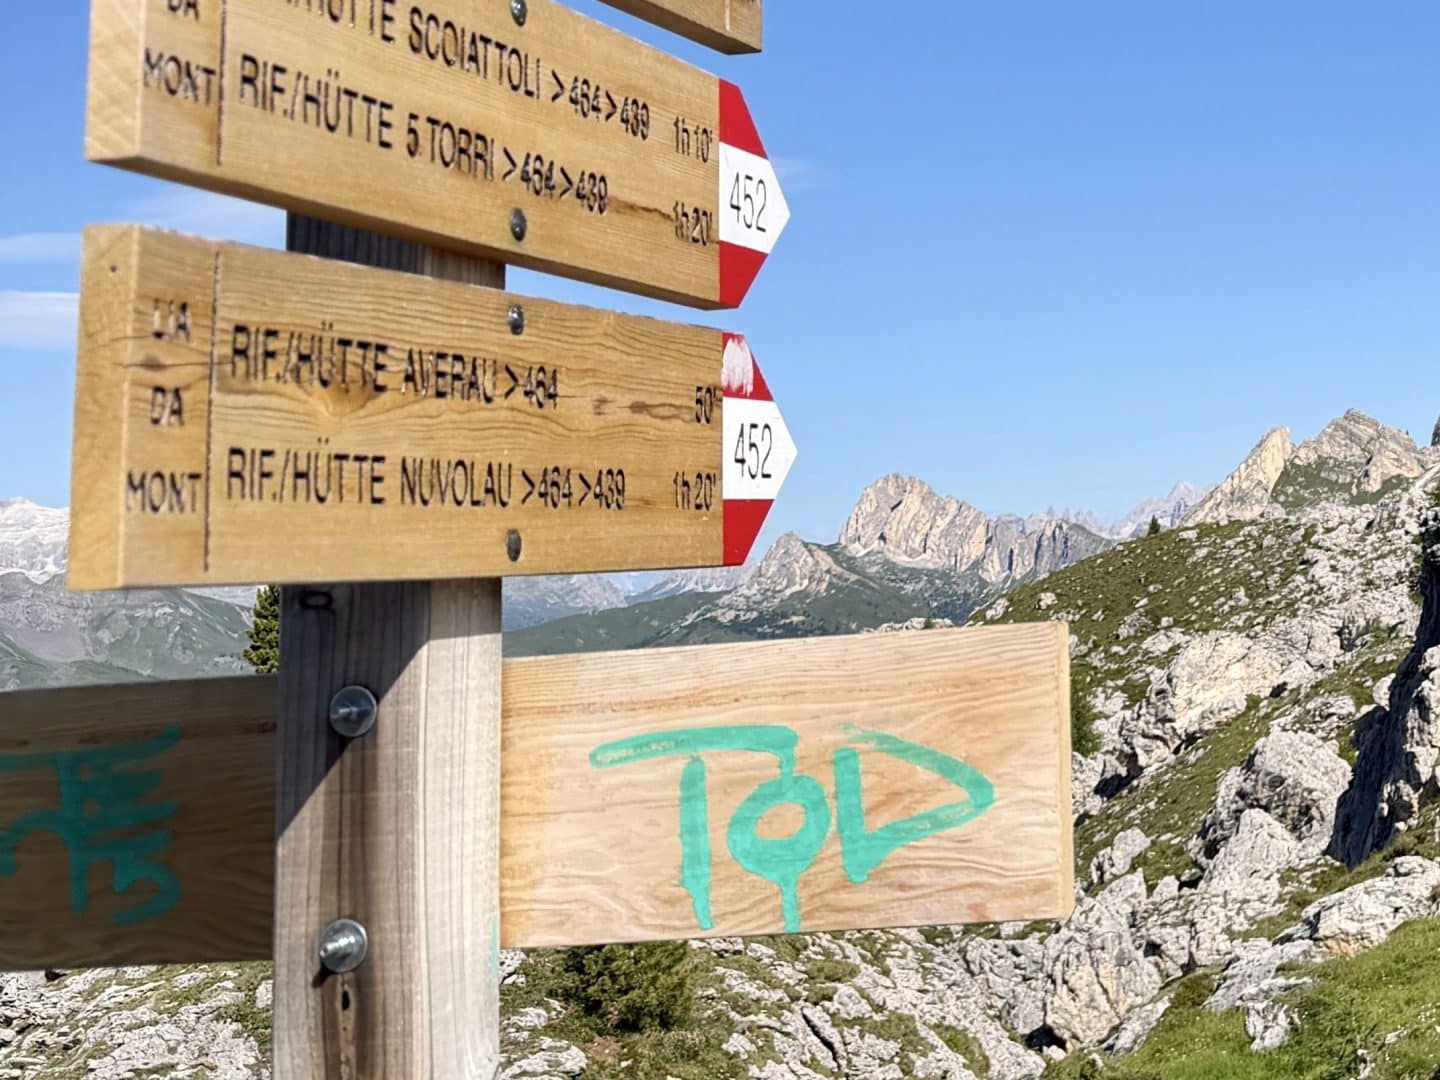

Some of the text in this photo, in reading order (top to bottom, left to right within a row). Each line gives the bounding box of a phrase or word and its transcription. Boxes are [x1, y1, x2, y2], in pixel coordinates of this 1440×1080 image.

[143, 47, 216, 105] MONT
[407, 6, 540, 100] SCOIATTOLI
[426, 116, 495, 182] TORRI
[730, 172, 766, 232] 452
[152, 298, 190, 343] LIA
[402, 347, 497, 404] AVERAU
[150, 386, 184, 427] DA
[734, 423, 773, 480] 452
[126, 471, 202, 515] MONT
[400, 456, 512, 508] NUVOLAU
